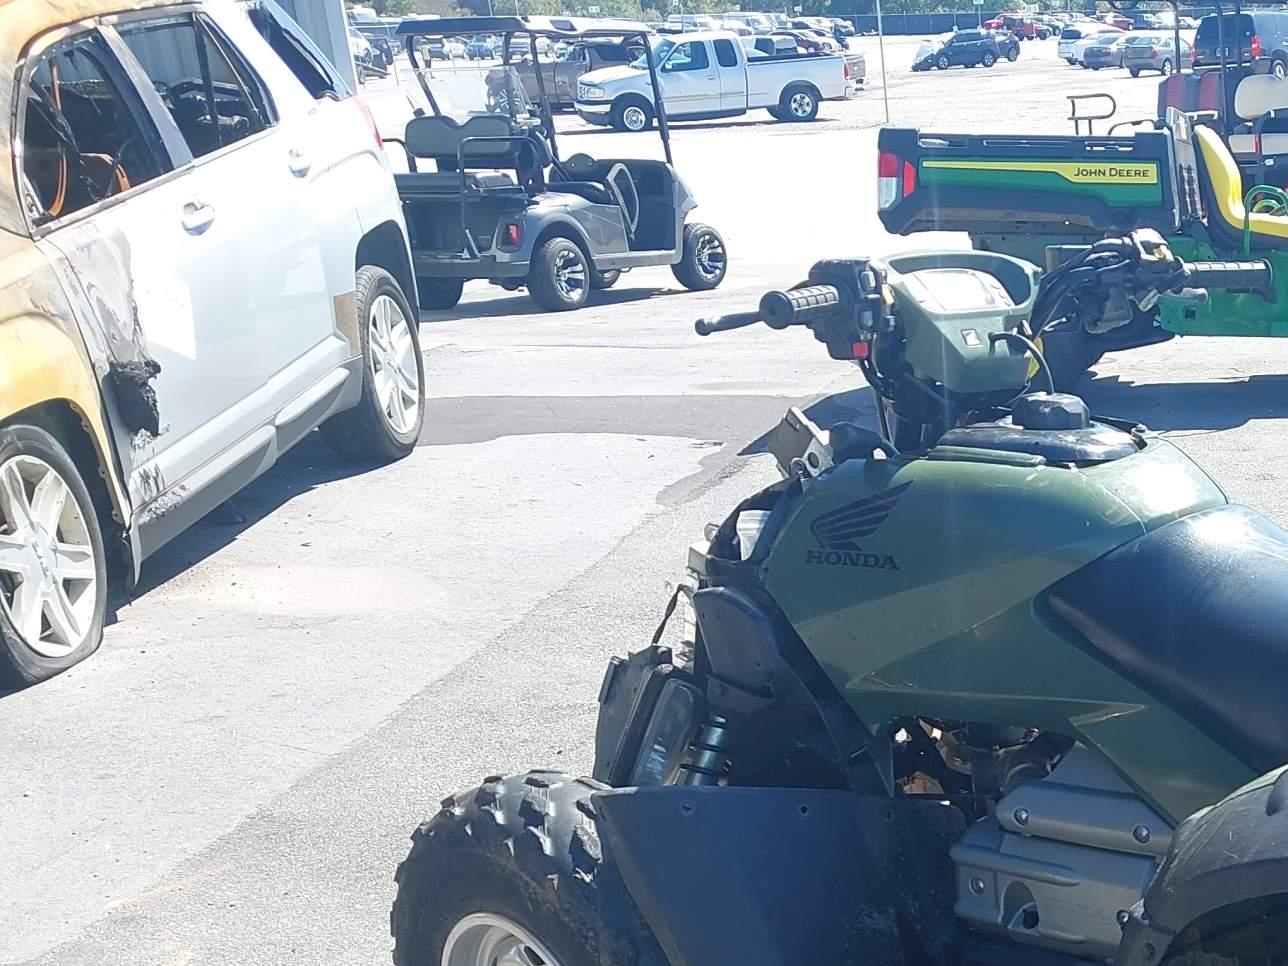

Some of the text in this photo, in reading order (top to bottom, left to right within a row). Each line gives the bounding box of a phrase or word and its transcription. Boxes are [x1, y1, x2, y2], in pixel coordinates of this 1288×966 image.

[1074, 167, 1149, 180] JOHN DEERE
[804, 549, 899, 570] HONDA
